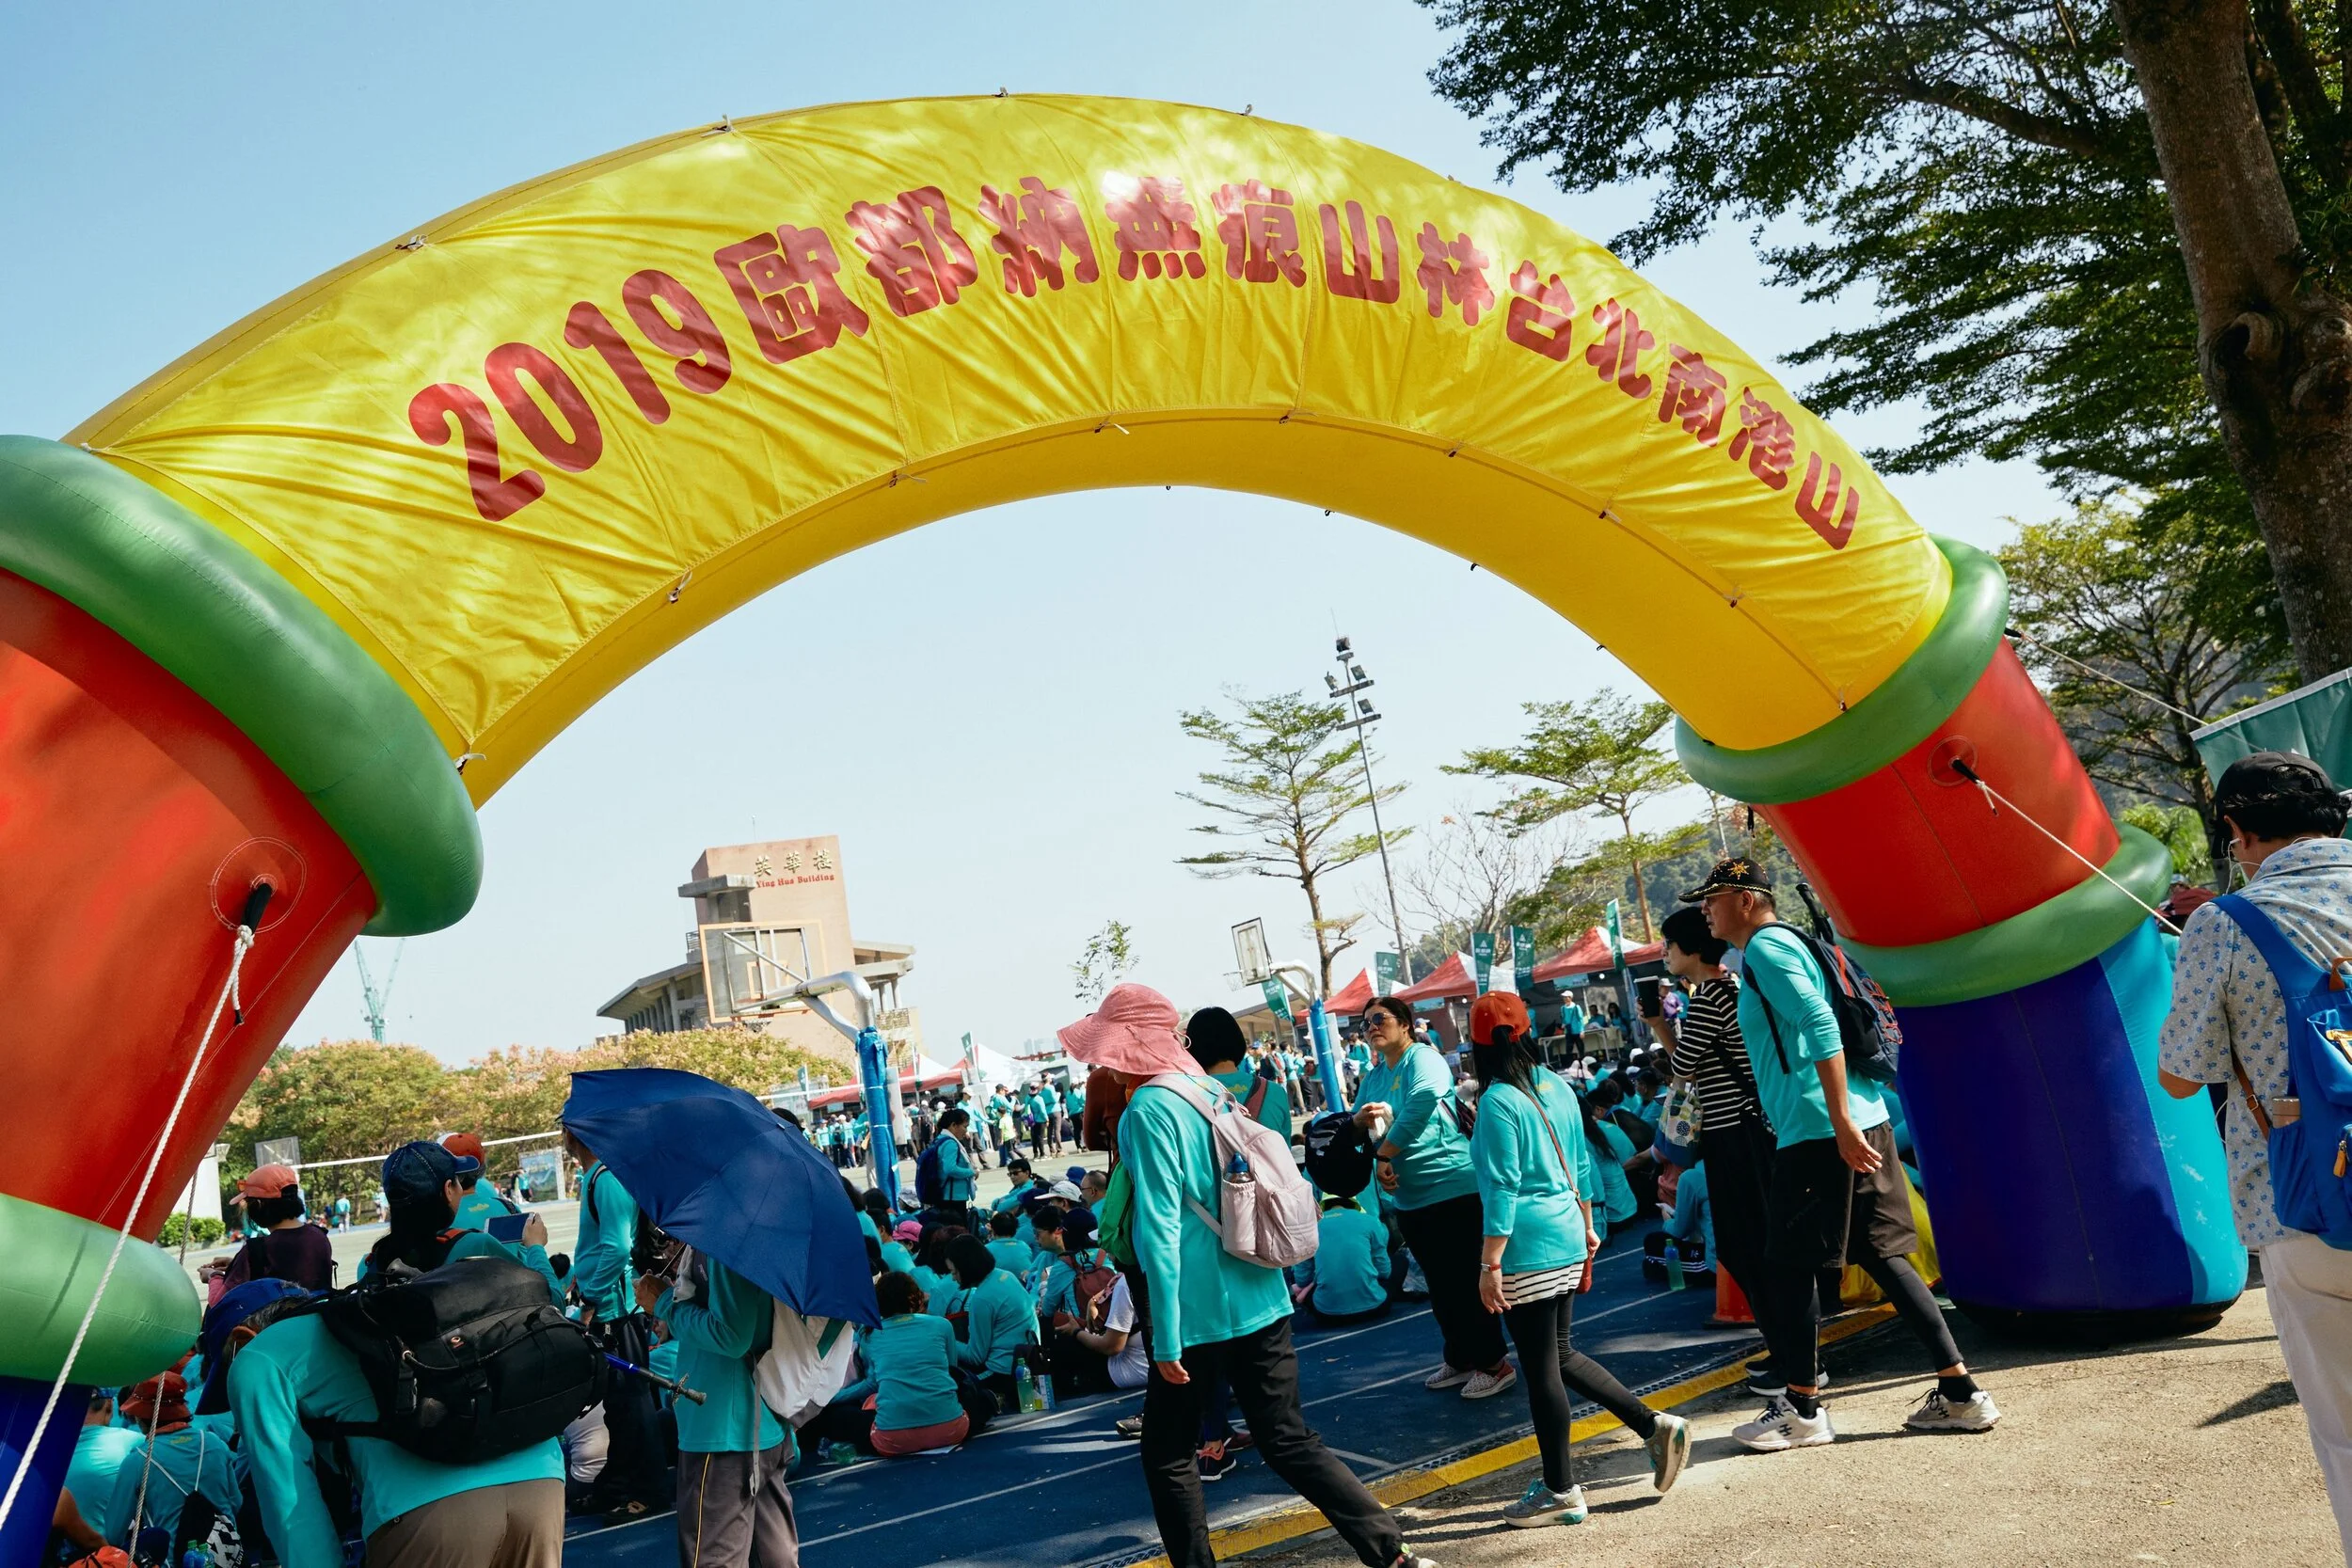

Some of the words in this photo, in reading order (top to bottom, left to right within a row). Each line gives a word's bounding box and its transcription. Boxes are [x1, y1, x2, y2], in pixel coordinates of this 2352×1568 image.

[755, 879, 775, 888] Ying
[778, 877, 794, 886] Hua
[797, 874, 834, 884] Building
